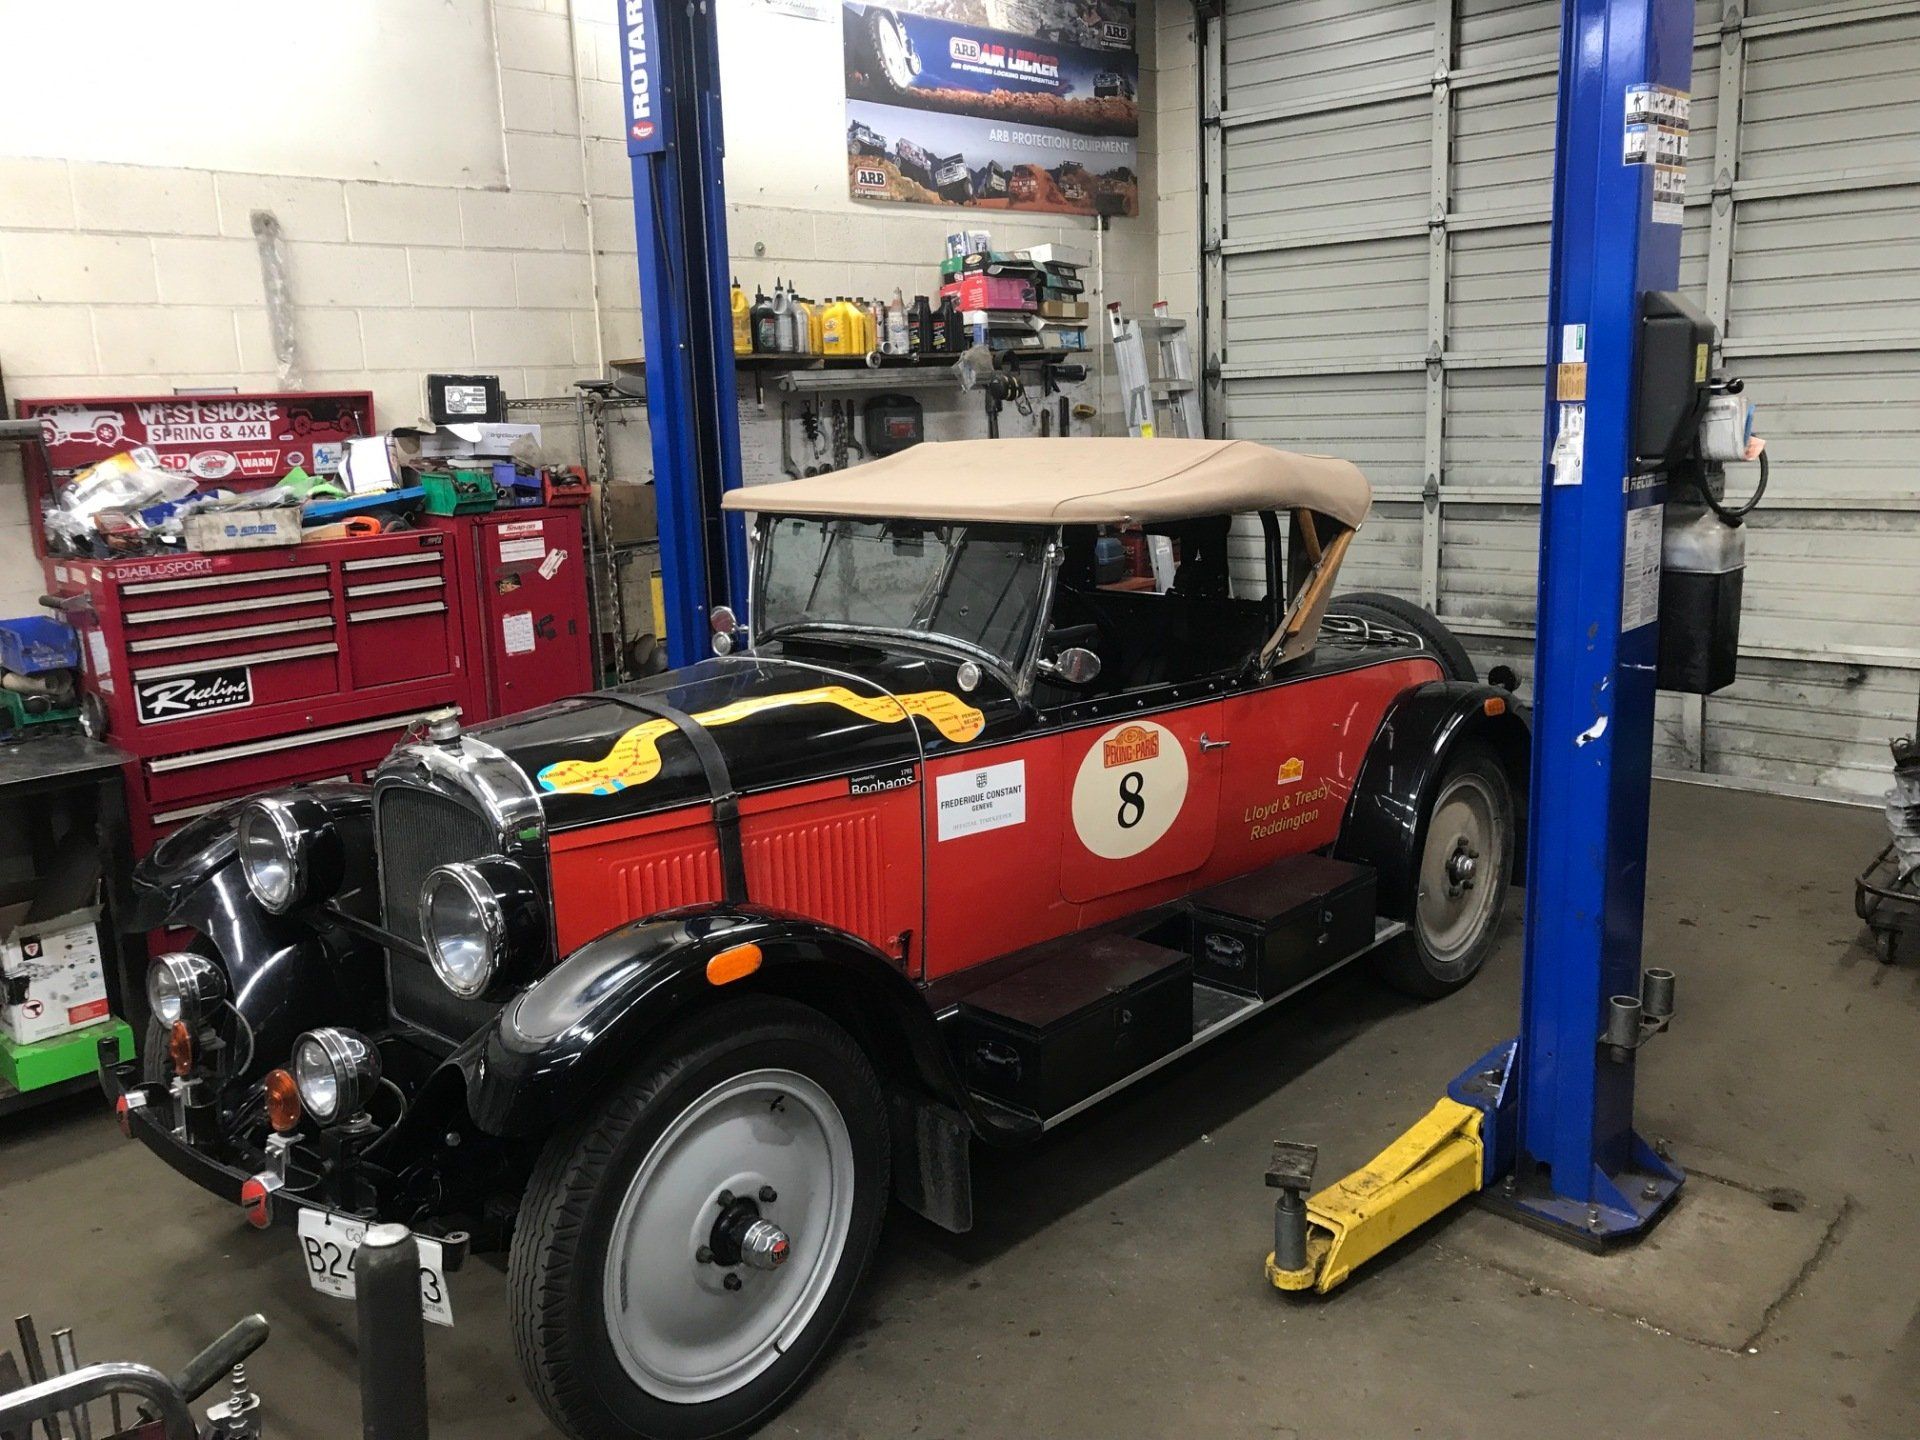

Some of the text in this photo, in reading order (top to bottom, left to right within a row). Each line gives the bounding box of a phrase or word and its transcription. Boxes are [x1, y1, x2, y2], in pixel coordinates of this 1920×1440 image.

[1105, 25, 1128, 39] ARB
[953, 42, 1059, 77] ARB AIR LOCKER
[951, 62, 1060, 86] AIR OPERATED LOCKING DIFFERENTIALS
[989, 129, 1129, 154] ARB PROTECTION EQUIPMENT
[860, 171, 884, 185] ARB
[152, 426, 215, 442] SPRING
[220, 425, 233, 439] &
[242, 457, 274, 468] WARN
[241, 524, 257, 535] AUTO
[258, 523, 277, 533] PARTS
[506, 523, 536, 532] Snap-on
[141, 677, 246, 715] Raceline
[1105, 734, 1157, 766] PEKING PARIS
[851, 776, 914, 795] Bonhams
[940, 785, 1022, 810] FREDERIQUE CONSTANT
[1118, 772, 1145, 829] 8
[1244, 784, 1331, 823] Lloyd & Treacy
[1250, 809, 1319, 841] Reddington
